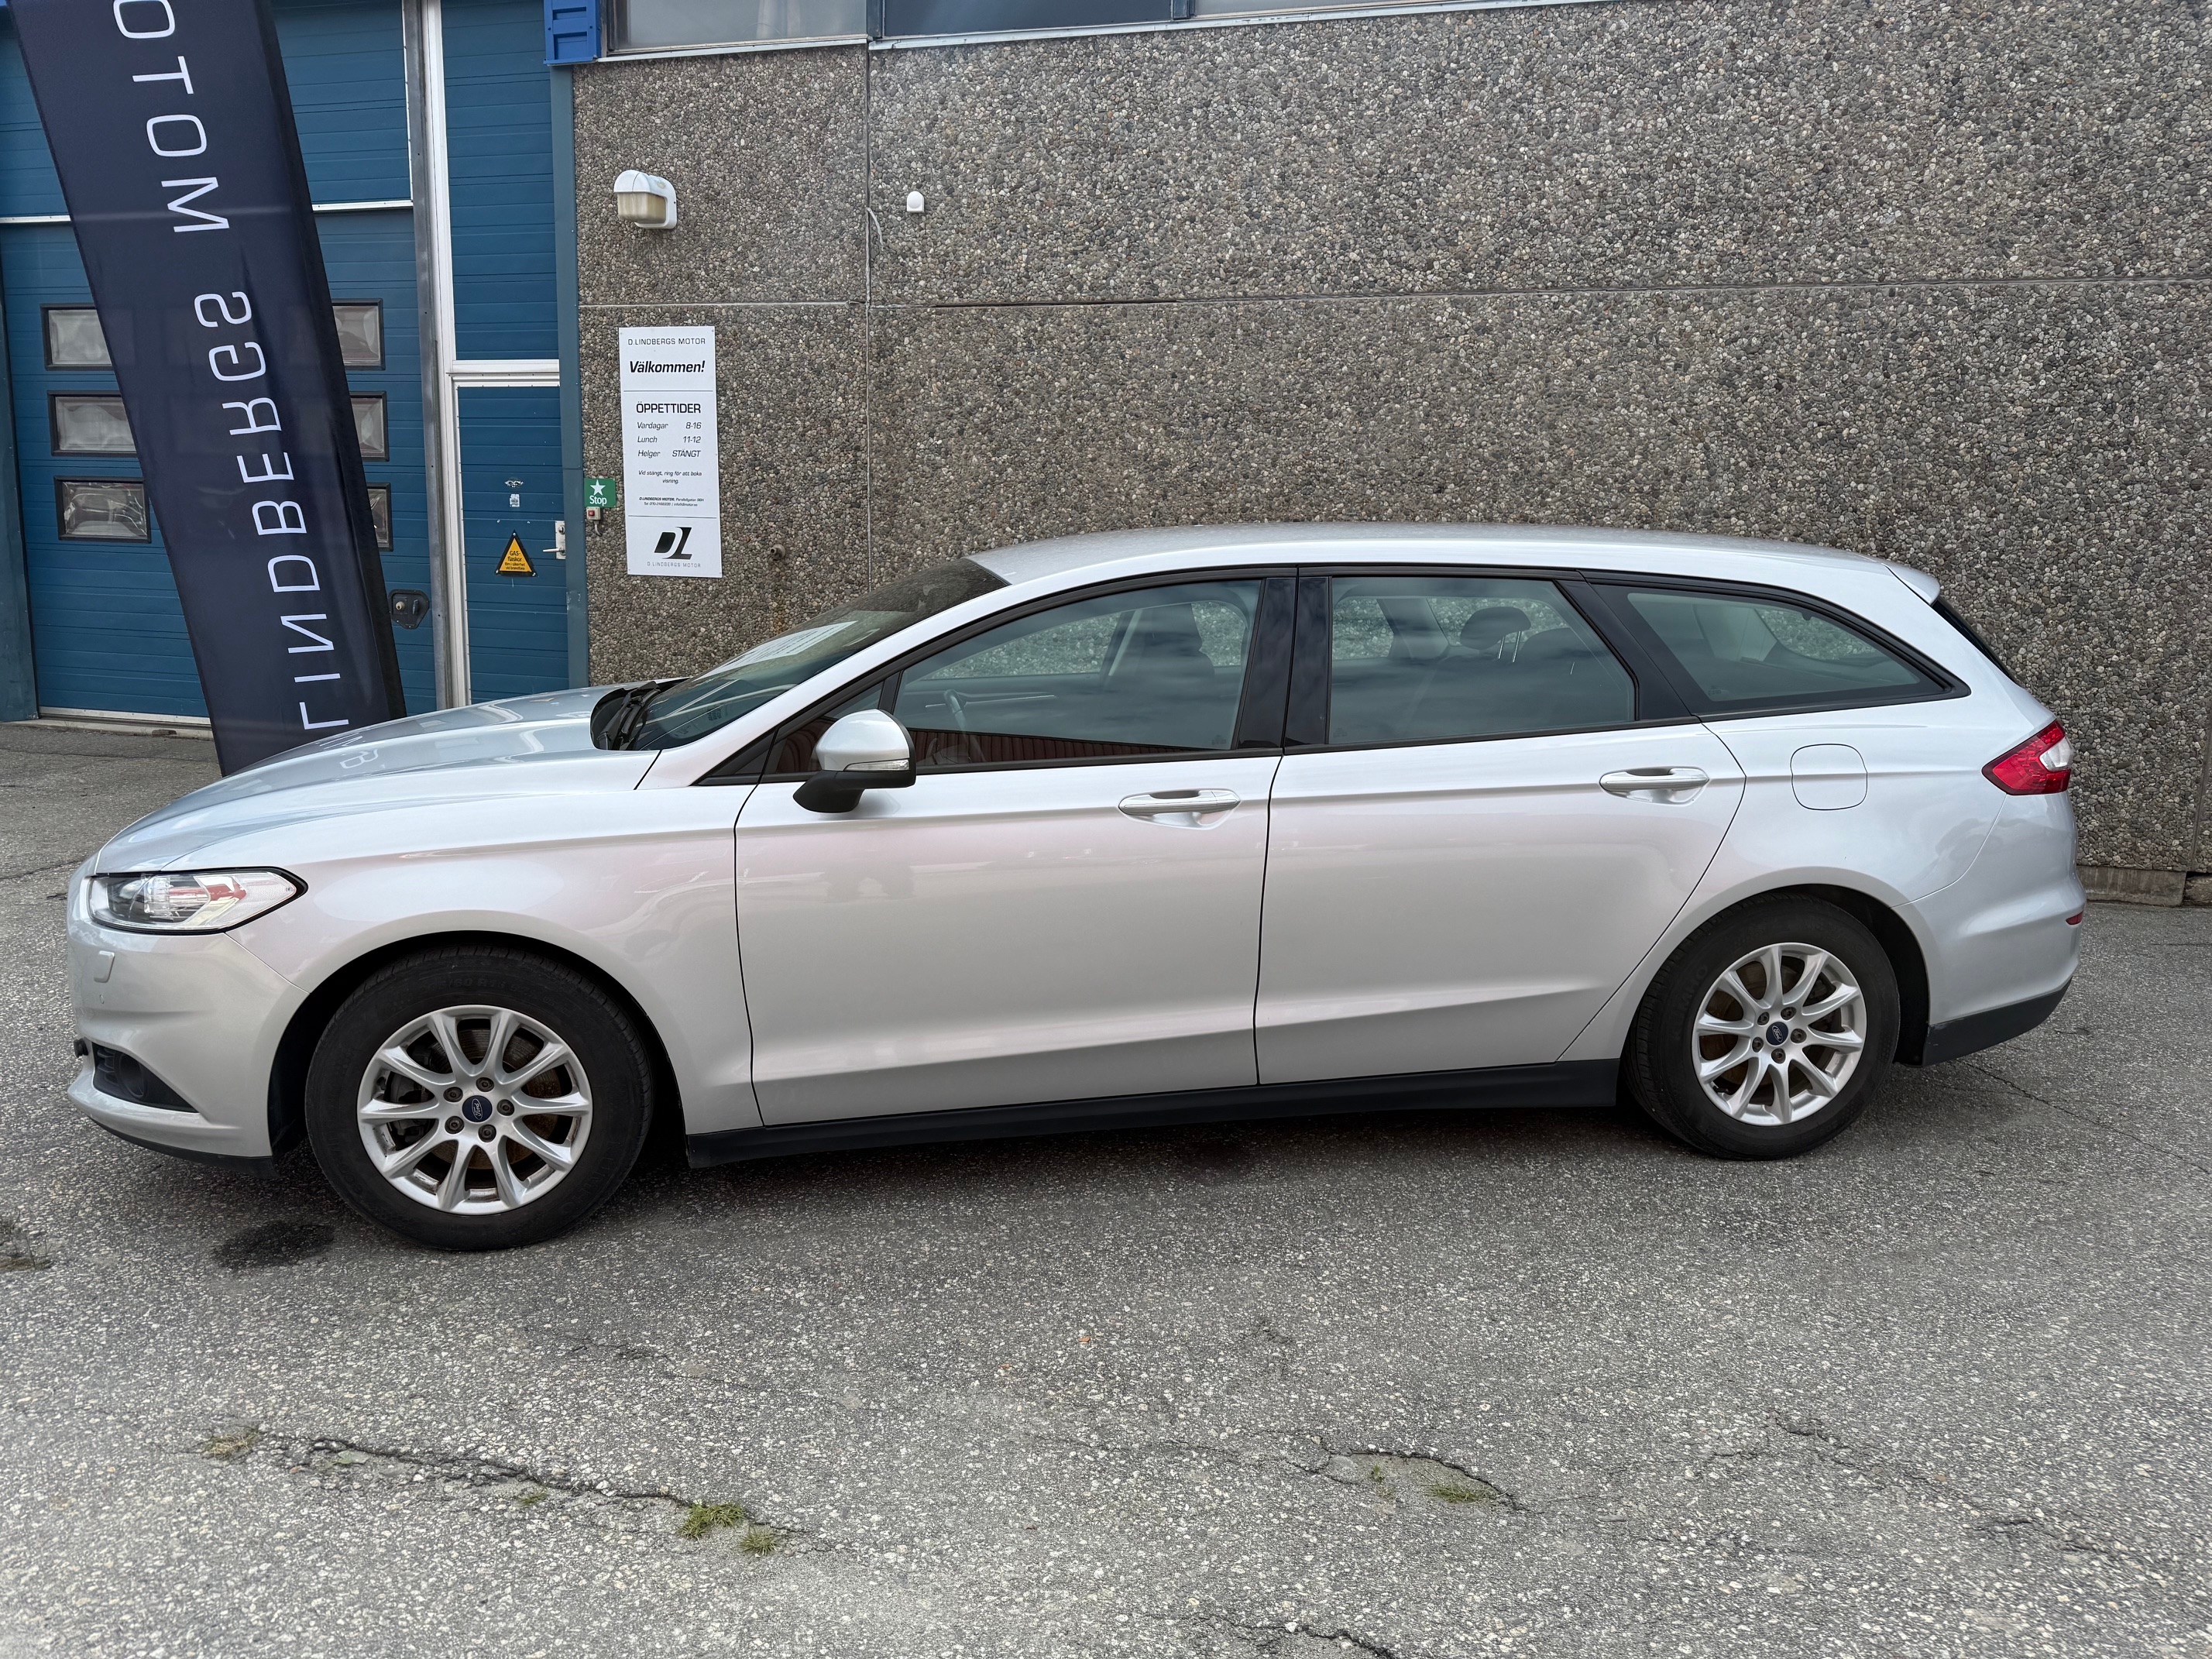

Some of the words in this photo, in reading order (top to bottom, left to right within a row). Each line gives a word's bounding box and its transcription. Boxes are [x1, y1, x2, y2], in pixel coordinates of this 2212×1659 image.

[630, 360, 706, 373] Välkommen!
[636, 400, 702, 414] ÖPPETTIDER
[637, 421, 669, 431] Vardagar
[637, 450, 661, 459] Helger
[672, 448, 702, 458] STÄNGT
[589, 495, 607, 507] Stop
